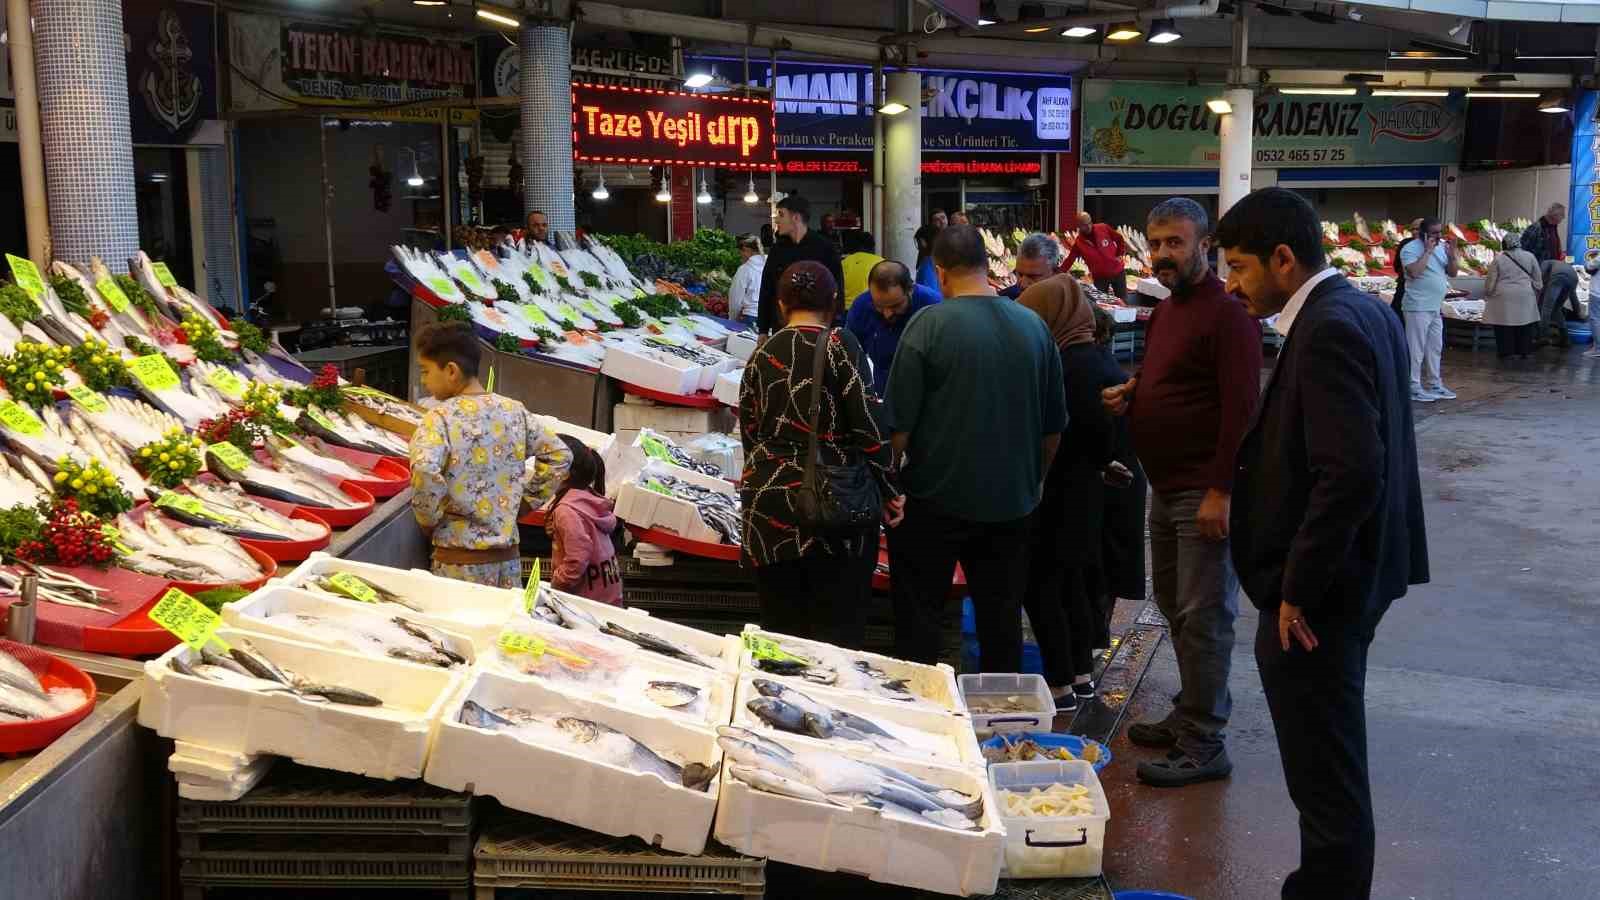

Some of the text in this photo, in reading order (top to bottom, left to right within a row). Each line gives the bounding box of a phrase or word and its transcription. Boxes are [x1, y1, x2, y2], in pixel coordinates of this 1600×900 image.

[748, 67, 1032, 125] MAN IKÇILIK
[582, 106, 642, 138] Taze
[647, 110, 701, 147] Yeşil
[1214, 102, 1364, 137] RADENİZ
[776, 133, 809, 147] optan
[828, 132, 874, 146] Peraken
[1256, 149, 1345, 162] 0532 465 57 25
